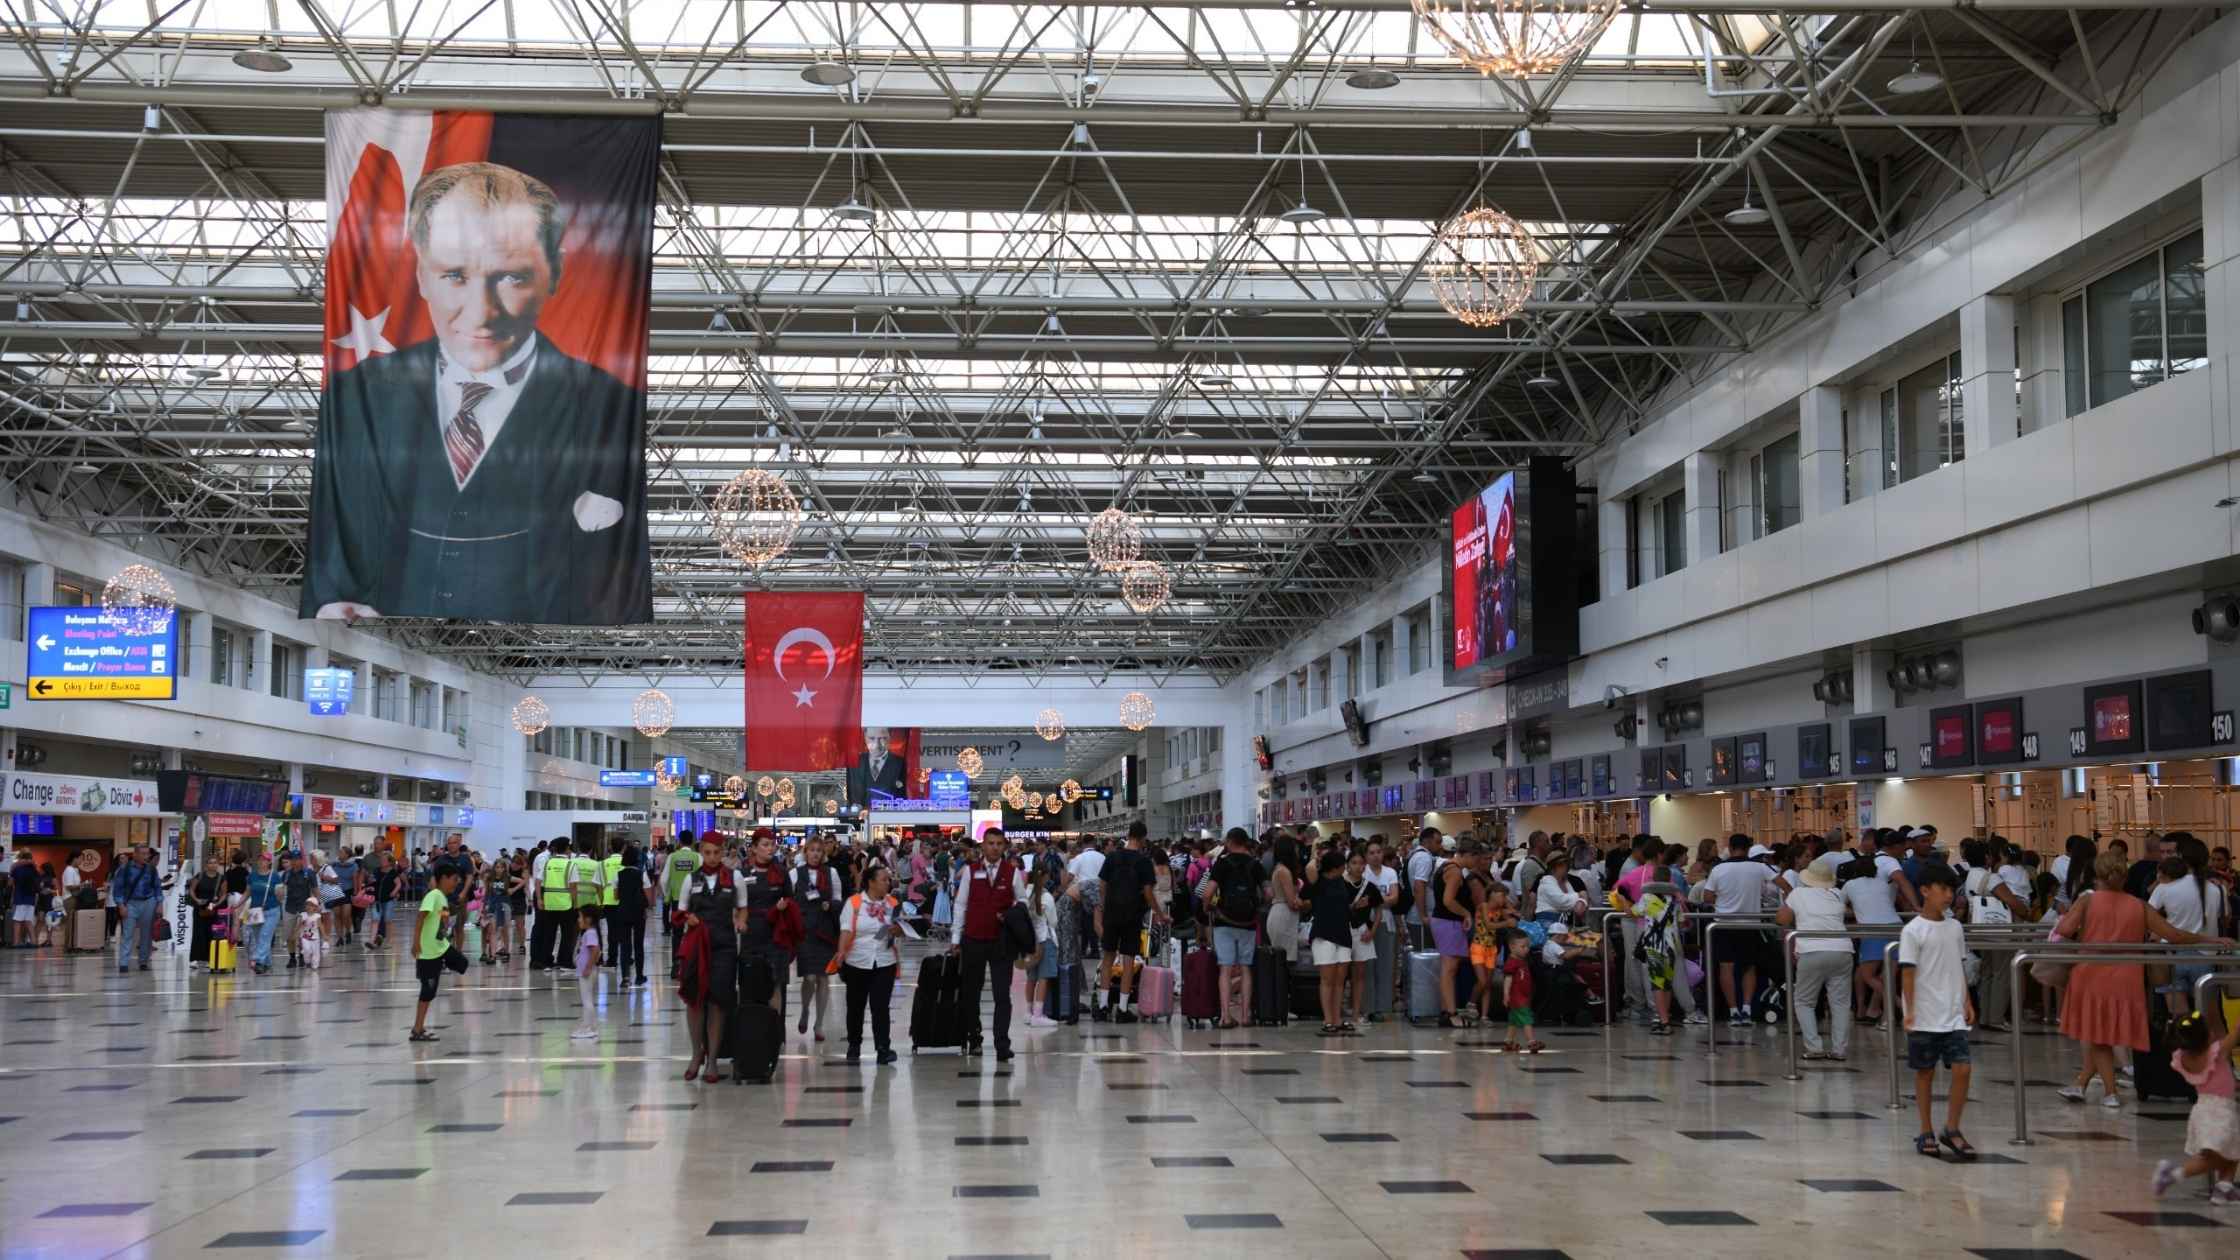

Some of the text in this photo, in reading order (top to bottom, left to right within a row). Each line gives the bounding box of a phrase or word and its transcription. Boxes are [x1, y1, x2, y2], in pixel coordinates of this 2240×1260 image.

[64, 646, 99, 657] Exchange
[100, 646, 123, 656] Office
[89, 681, 103, 691] Exit
[2211, 714, 2233, 741] 150
[2022, 735, 2038, 758] 148
[2070, 730, 2086, 754] 149
[1884, 750, 1897, 770] 146
[1920, 746, 1932, 766] 147
[13, 778, 53, 806] Change
[110, 787, 133, 806] Döviz
[175, 893, 190, 946] wispotter
